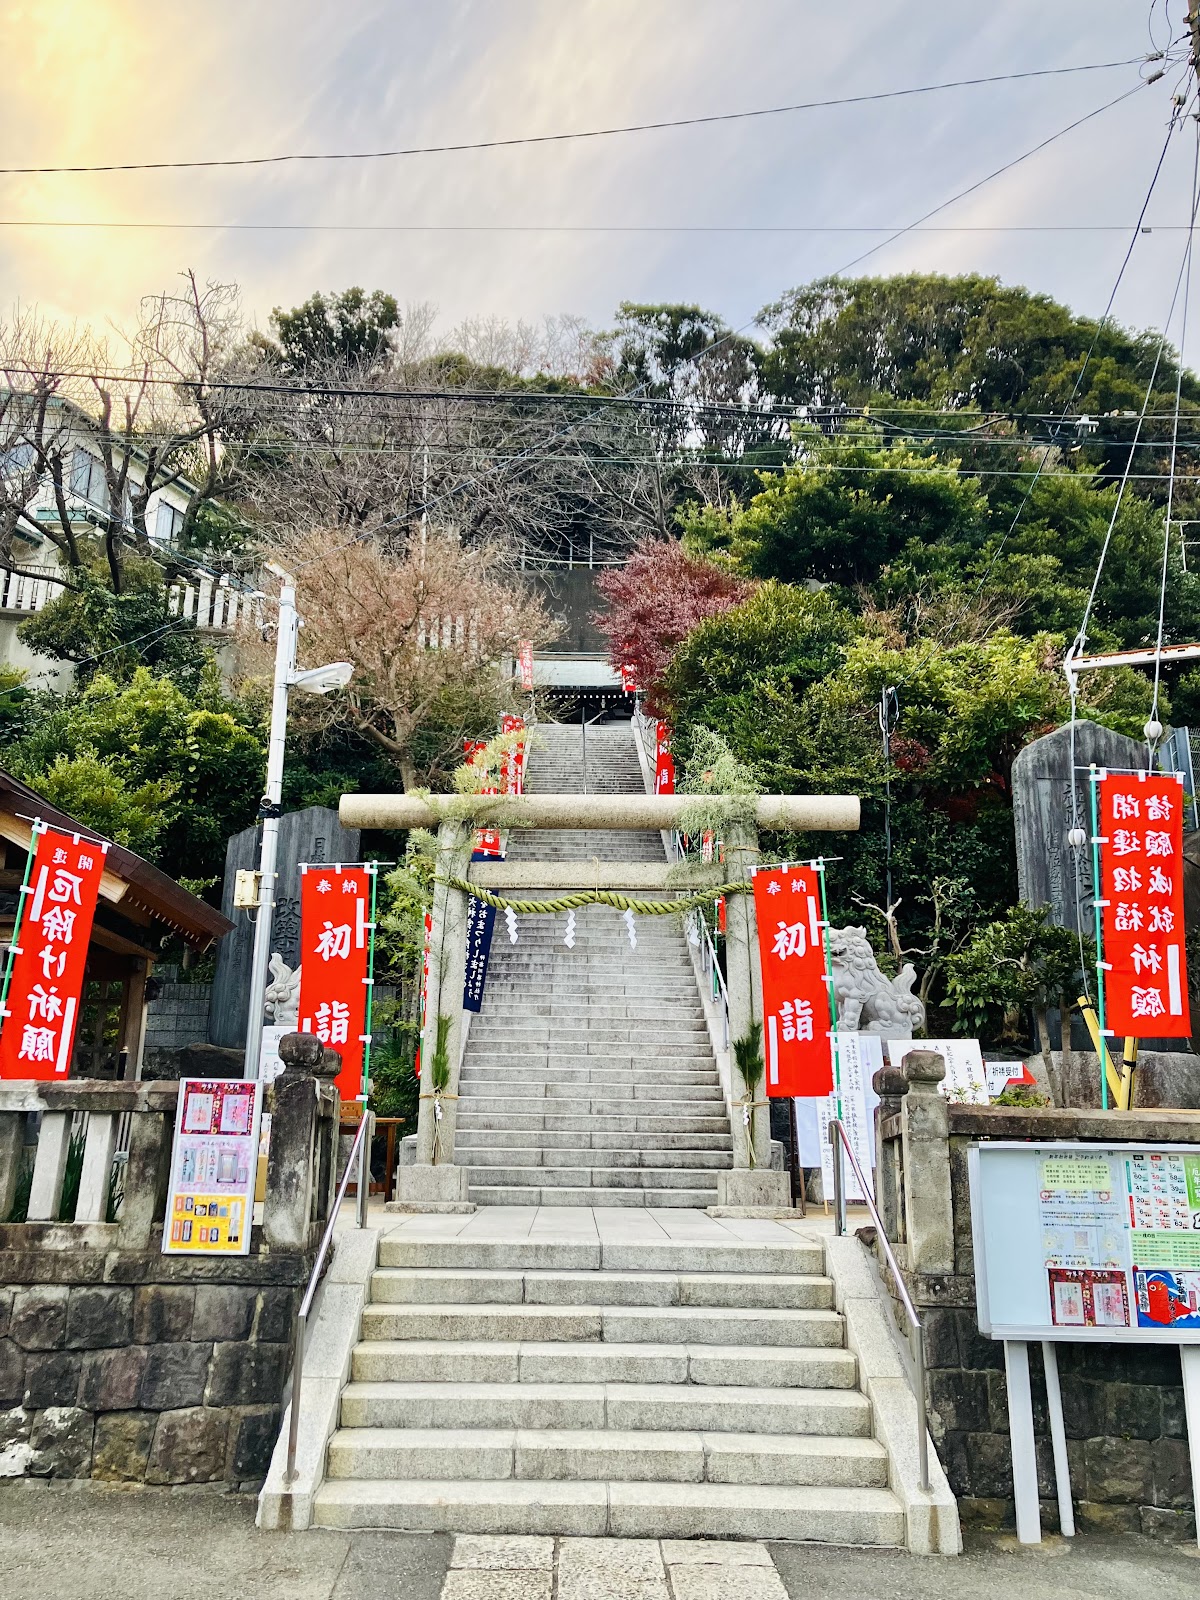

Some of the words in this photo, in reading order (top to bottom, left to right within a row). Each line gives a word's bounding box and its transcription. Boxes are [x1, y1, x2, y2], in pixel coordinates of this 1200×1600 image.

[316, 879, 357, 895] 奉納
[766, 879, 807, 895] 奉納
[313, 921, 353, 1046] 初詣
[773, 920, 814, 1042] 初詣
